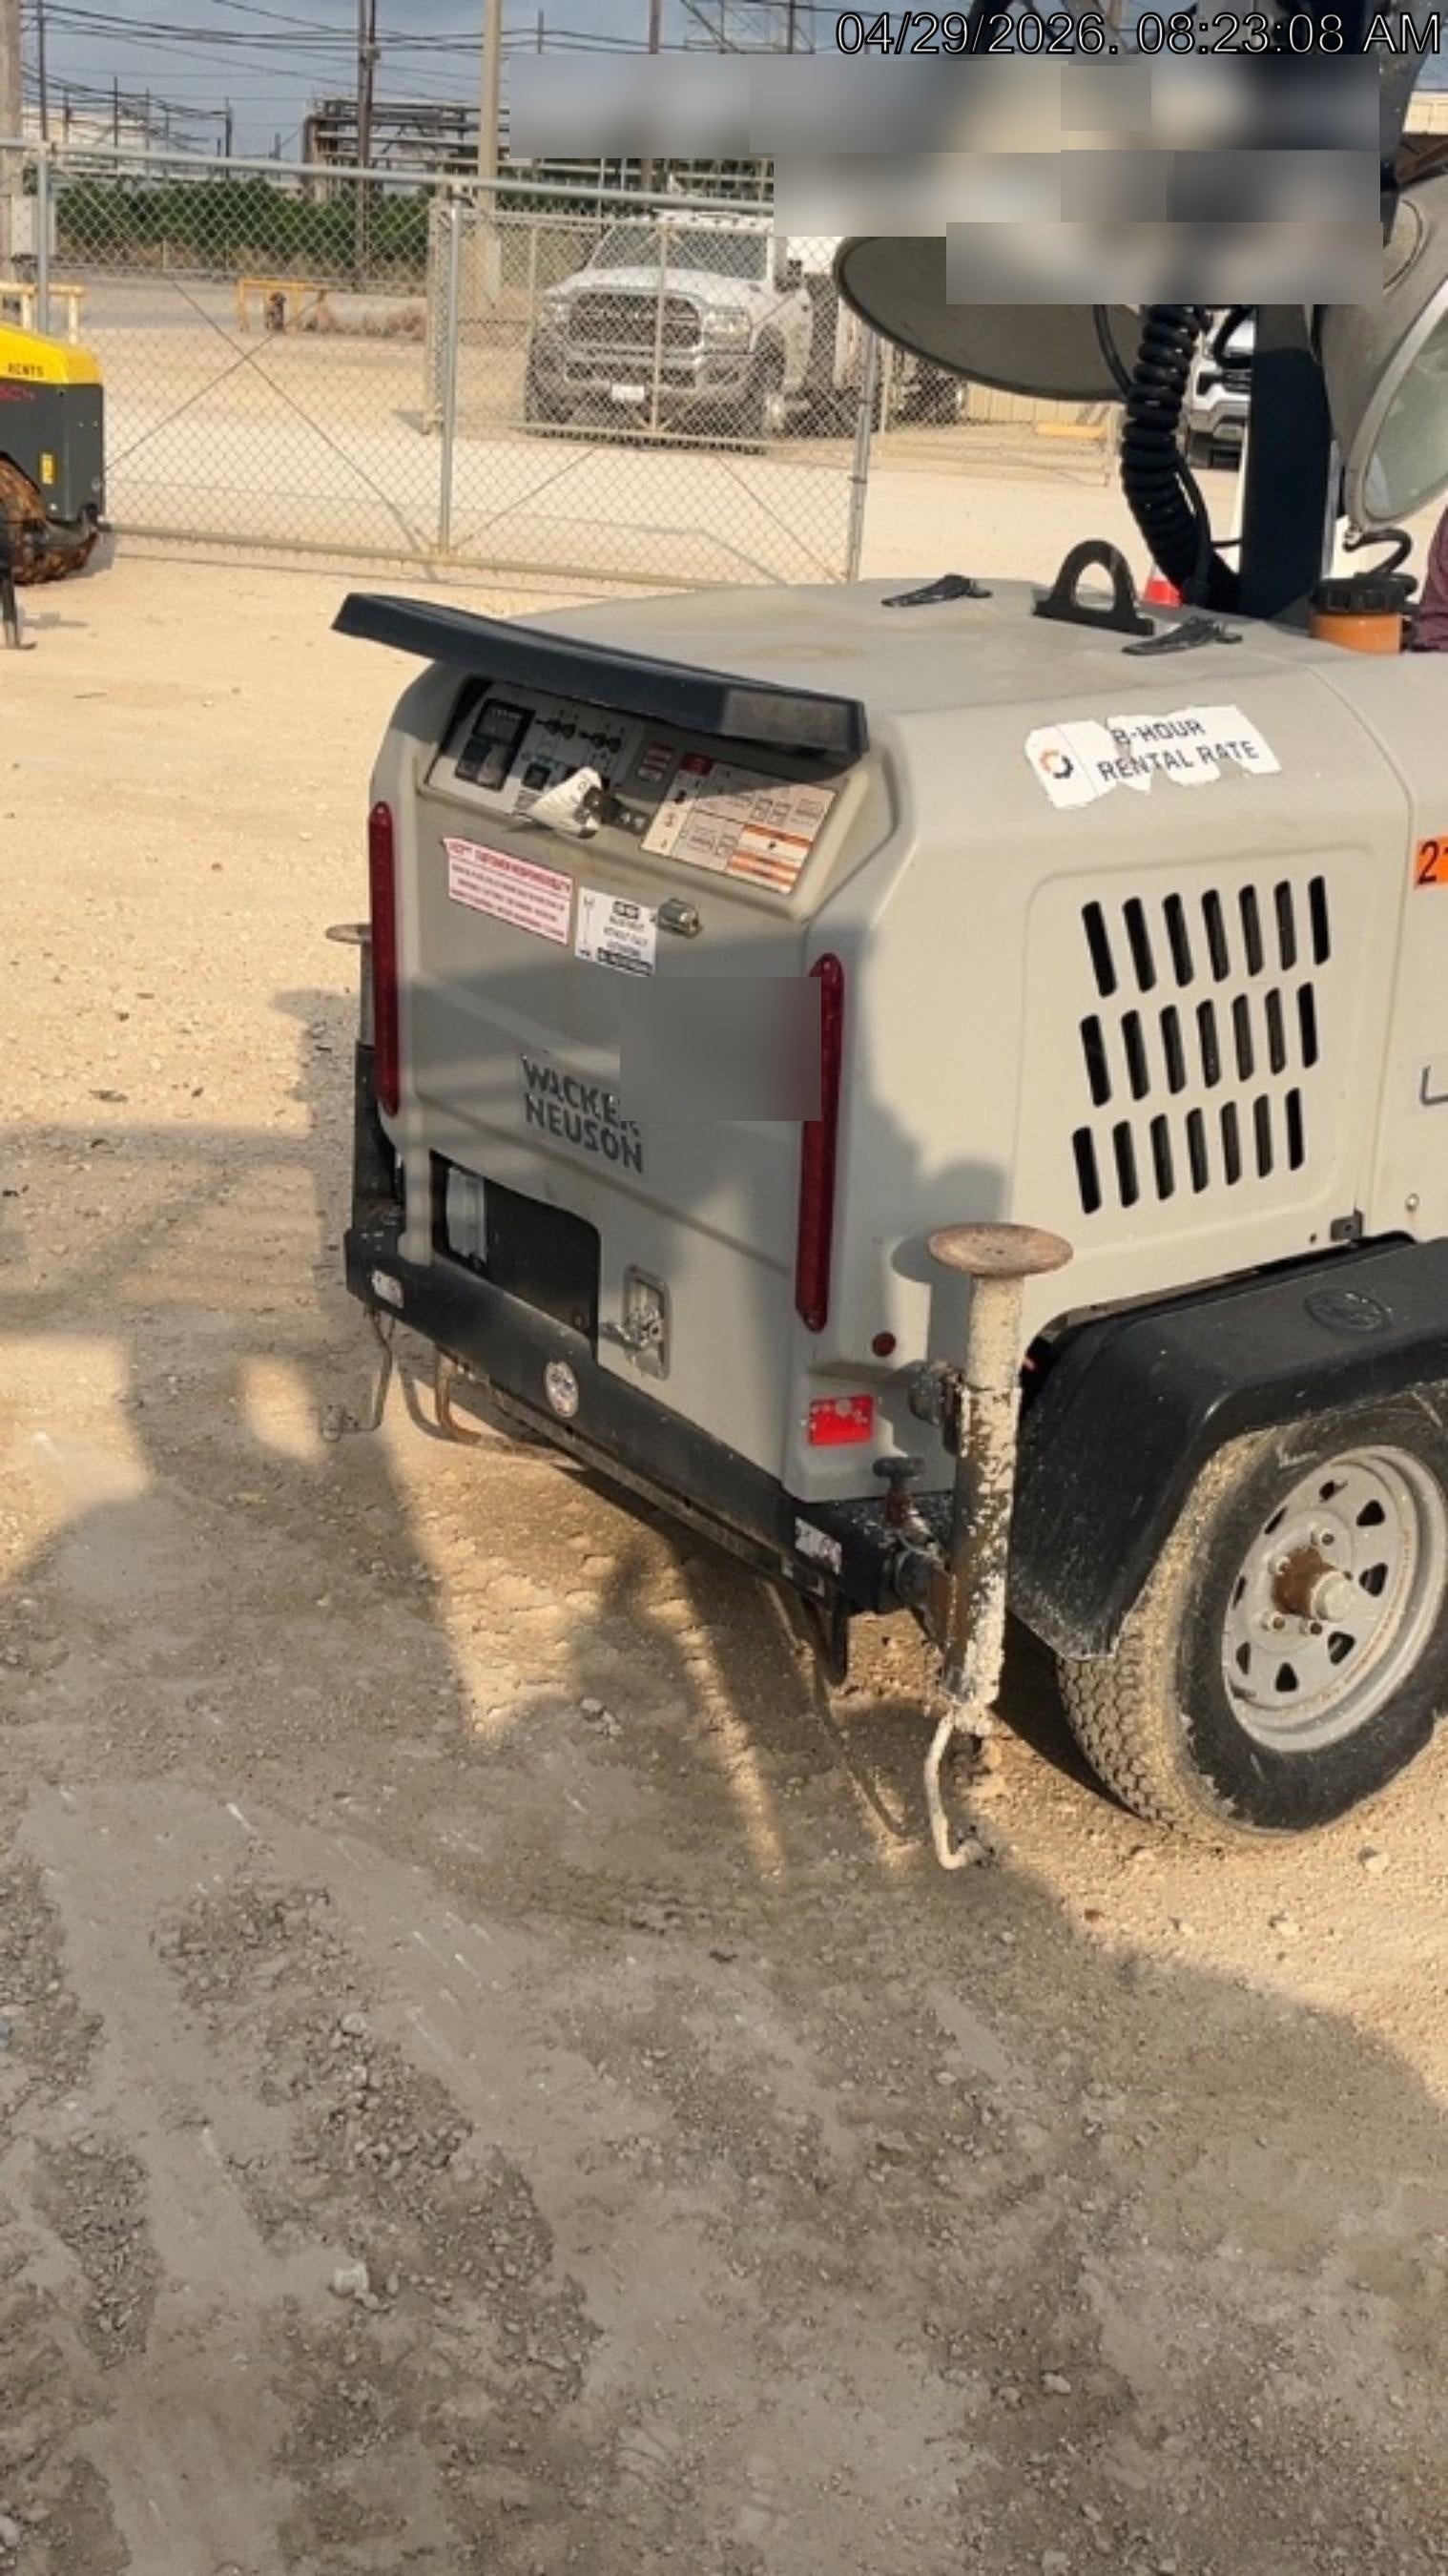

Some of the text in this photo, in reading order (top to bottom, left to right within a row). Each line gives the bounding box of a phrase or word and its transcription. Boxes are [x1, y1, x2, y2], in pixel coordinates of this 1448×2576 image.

[1096, 740, 1260, 781] RENTAL RATE
[1417, 841, 1448, 885] 2
[526, 1092, 643, 1174] NEUSON
